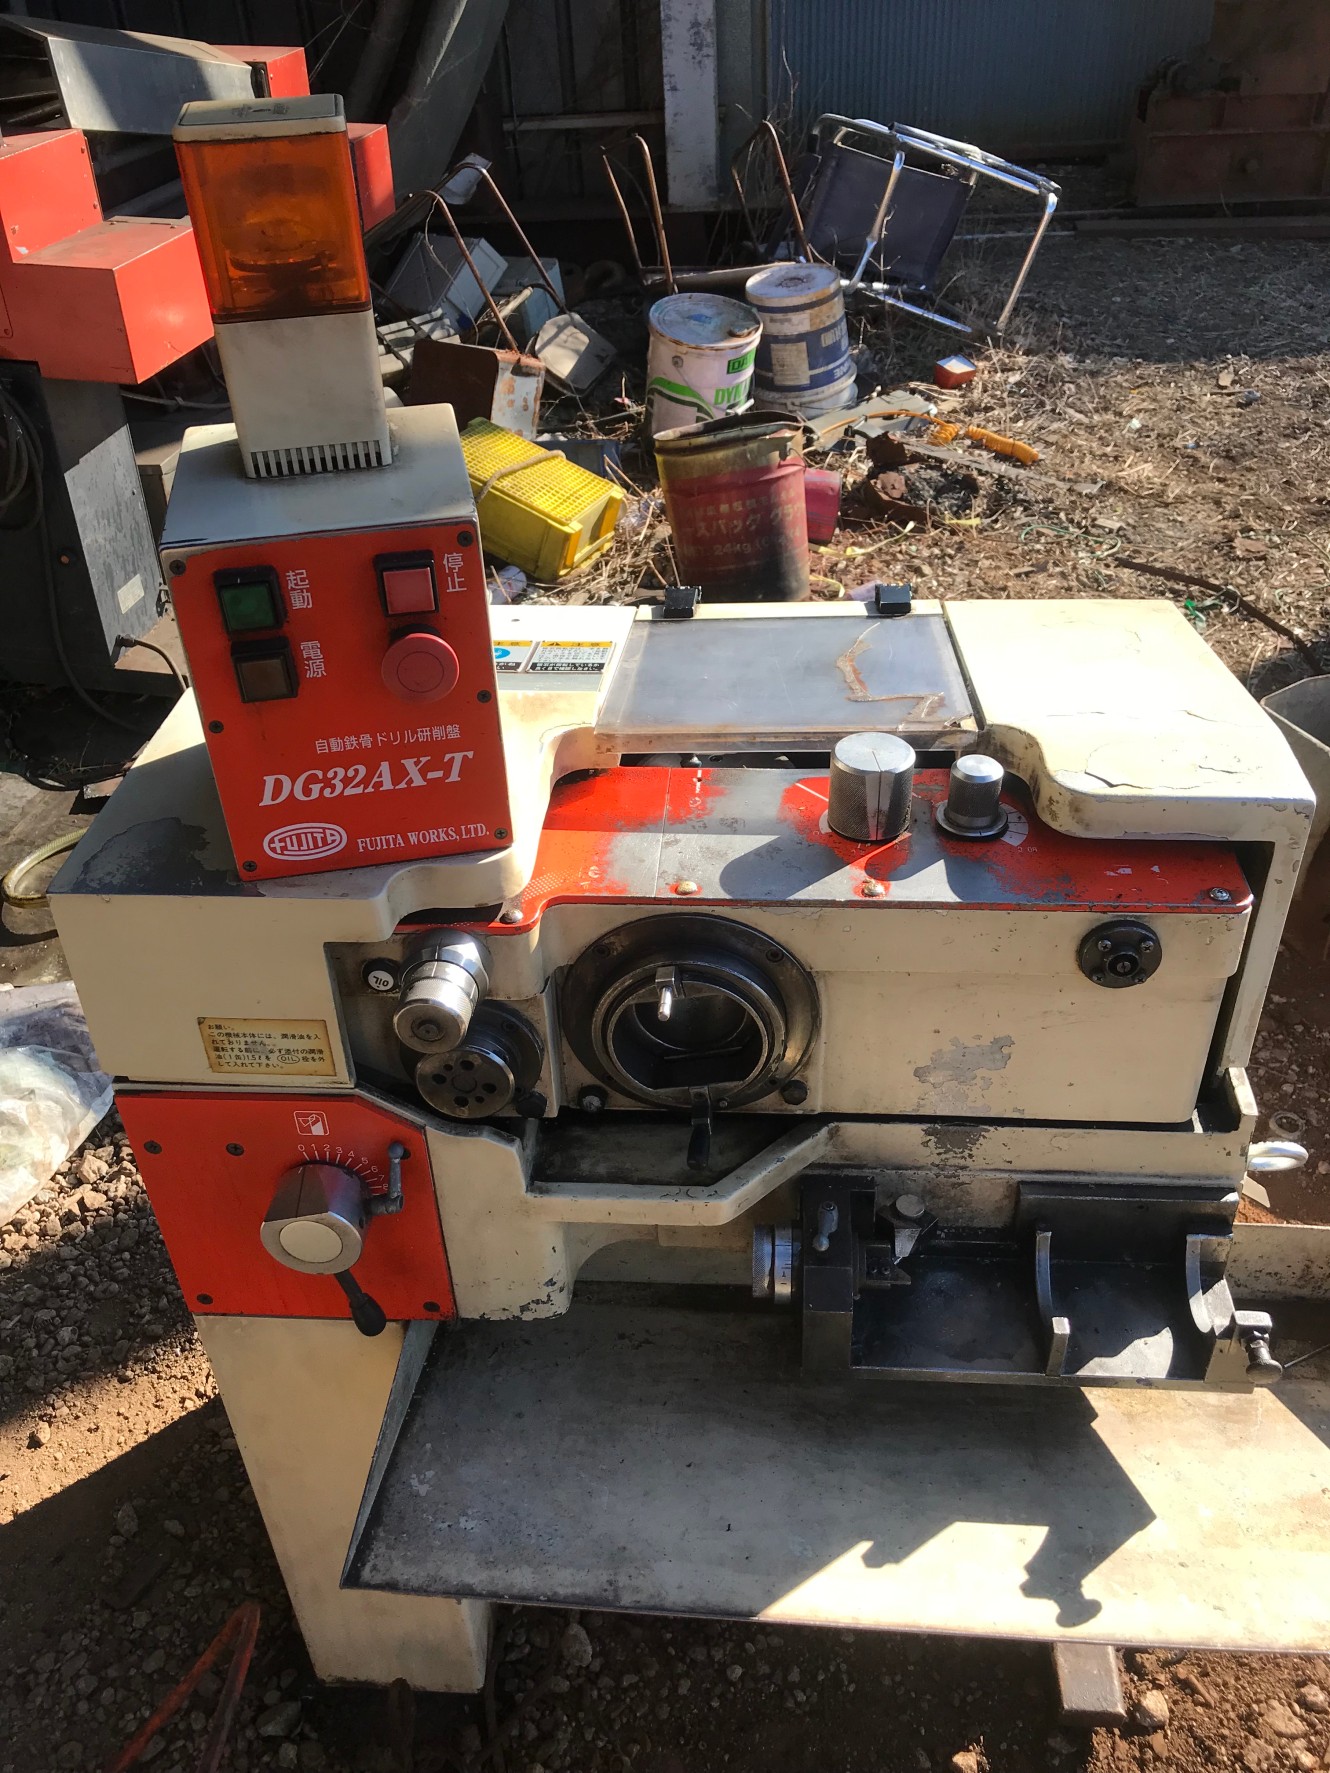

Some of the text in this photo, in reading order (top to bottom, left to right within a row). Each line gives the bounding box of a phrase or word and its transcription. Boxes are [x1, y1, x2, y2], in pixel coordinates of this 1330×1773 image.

[285, 570, 313, 610] 起動
[442, 552, 467, 594] 停止
[300, 640, 327, 679] 電源
[315, 724, 462, 754] 自動鉄骨ドリル研削盤
[258, 751, 474, 807] DG32AX-T
[267, 826, 344, 856] FUJITA
[357, 823, 490, 853] FUJITA WORKS, LTD.
[298, 1144, 305, 1152] 0
[348, 1150, 355, 1158] 4
[361, 1157, 369, 1165] 5
[371, 1165, 378, 1173] 6
